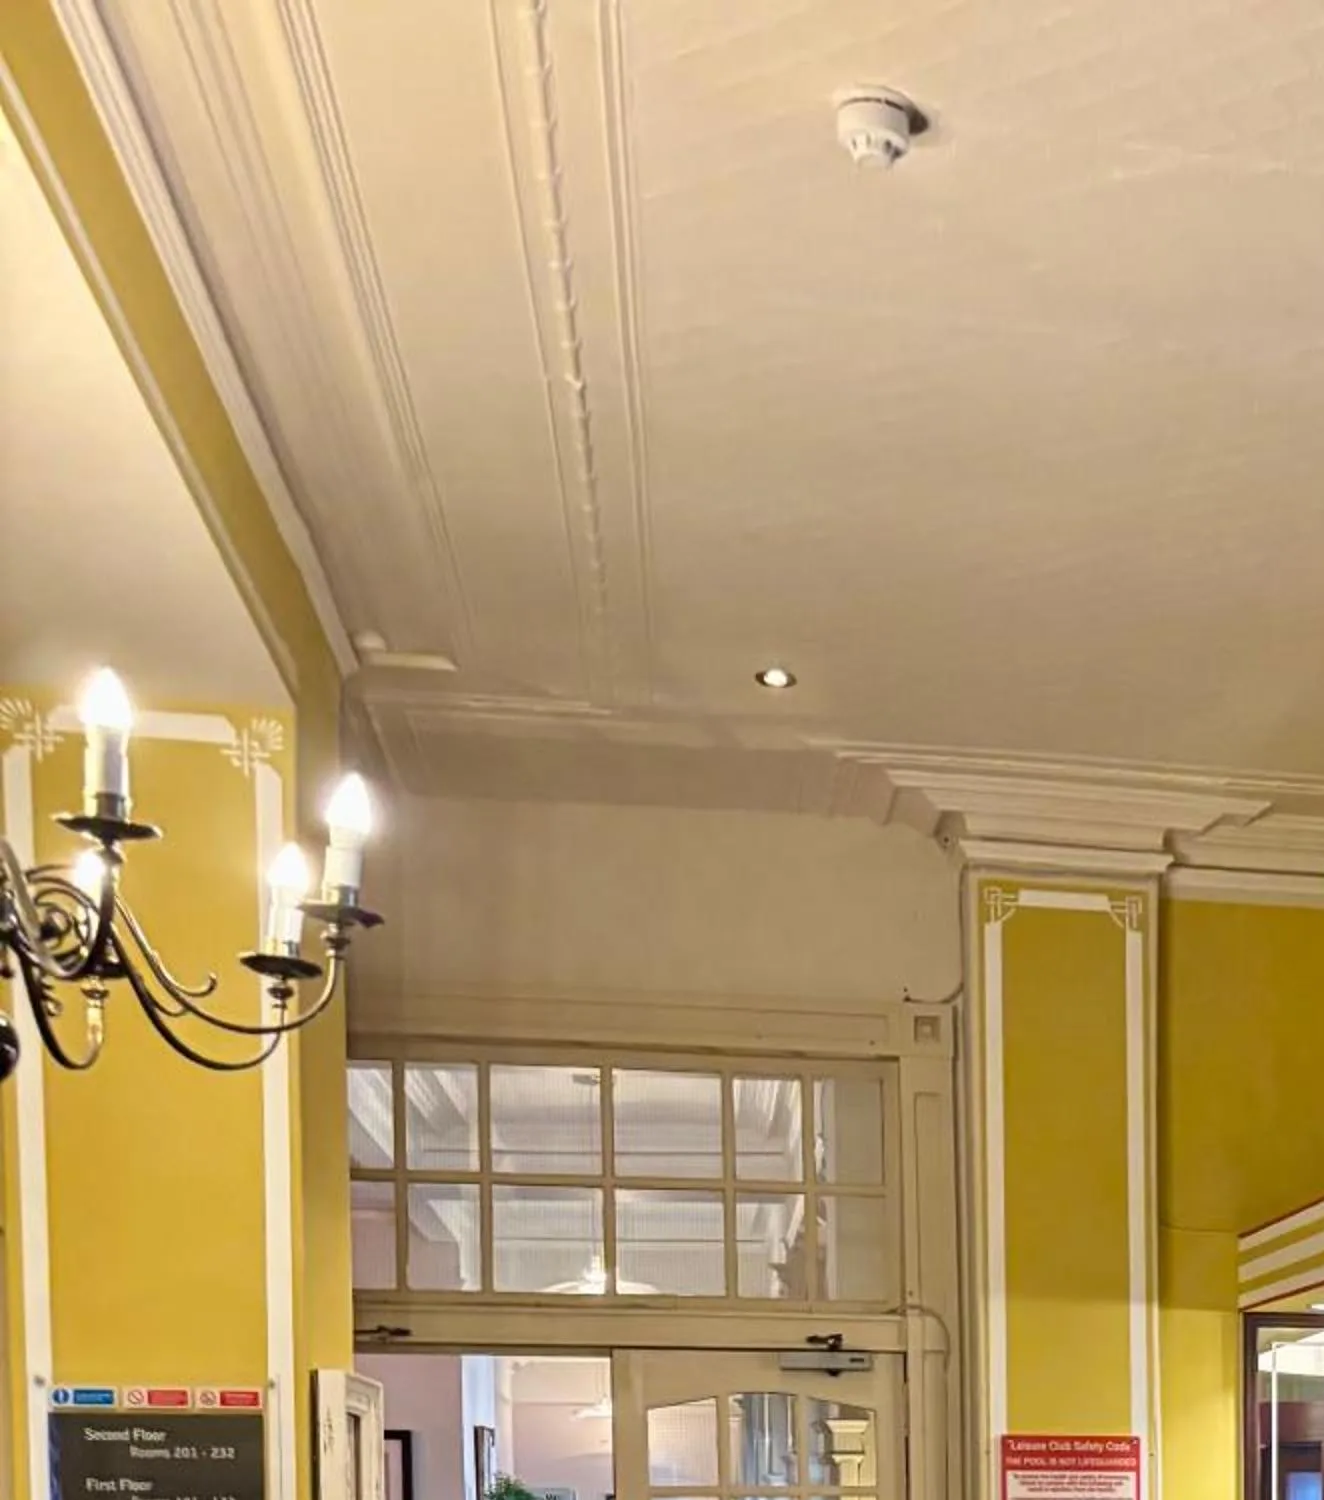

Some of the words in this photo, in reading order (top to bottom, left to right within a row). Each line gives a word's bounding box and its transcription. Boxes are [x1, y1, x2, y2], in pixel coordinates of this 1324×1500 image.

[84, 1428, 130, 1441] Second
[133, 1428, 167, 1441] Floor
[130, 1446, 171, 1458] Rooms
[173, 1446, 198, 1458] 201
[1074, 1440, 1103, 1453] Safety
[1105, 1440, 1131, 1451] Code
[1023, 1457, 1047, 1466] POOL
[86, 1478, 117, 1491] First
[119, 1478, 153, 1491] Floor
